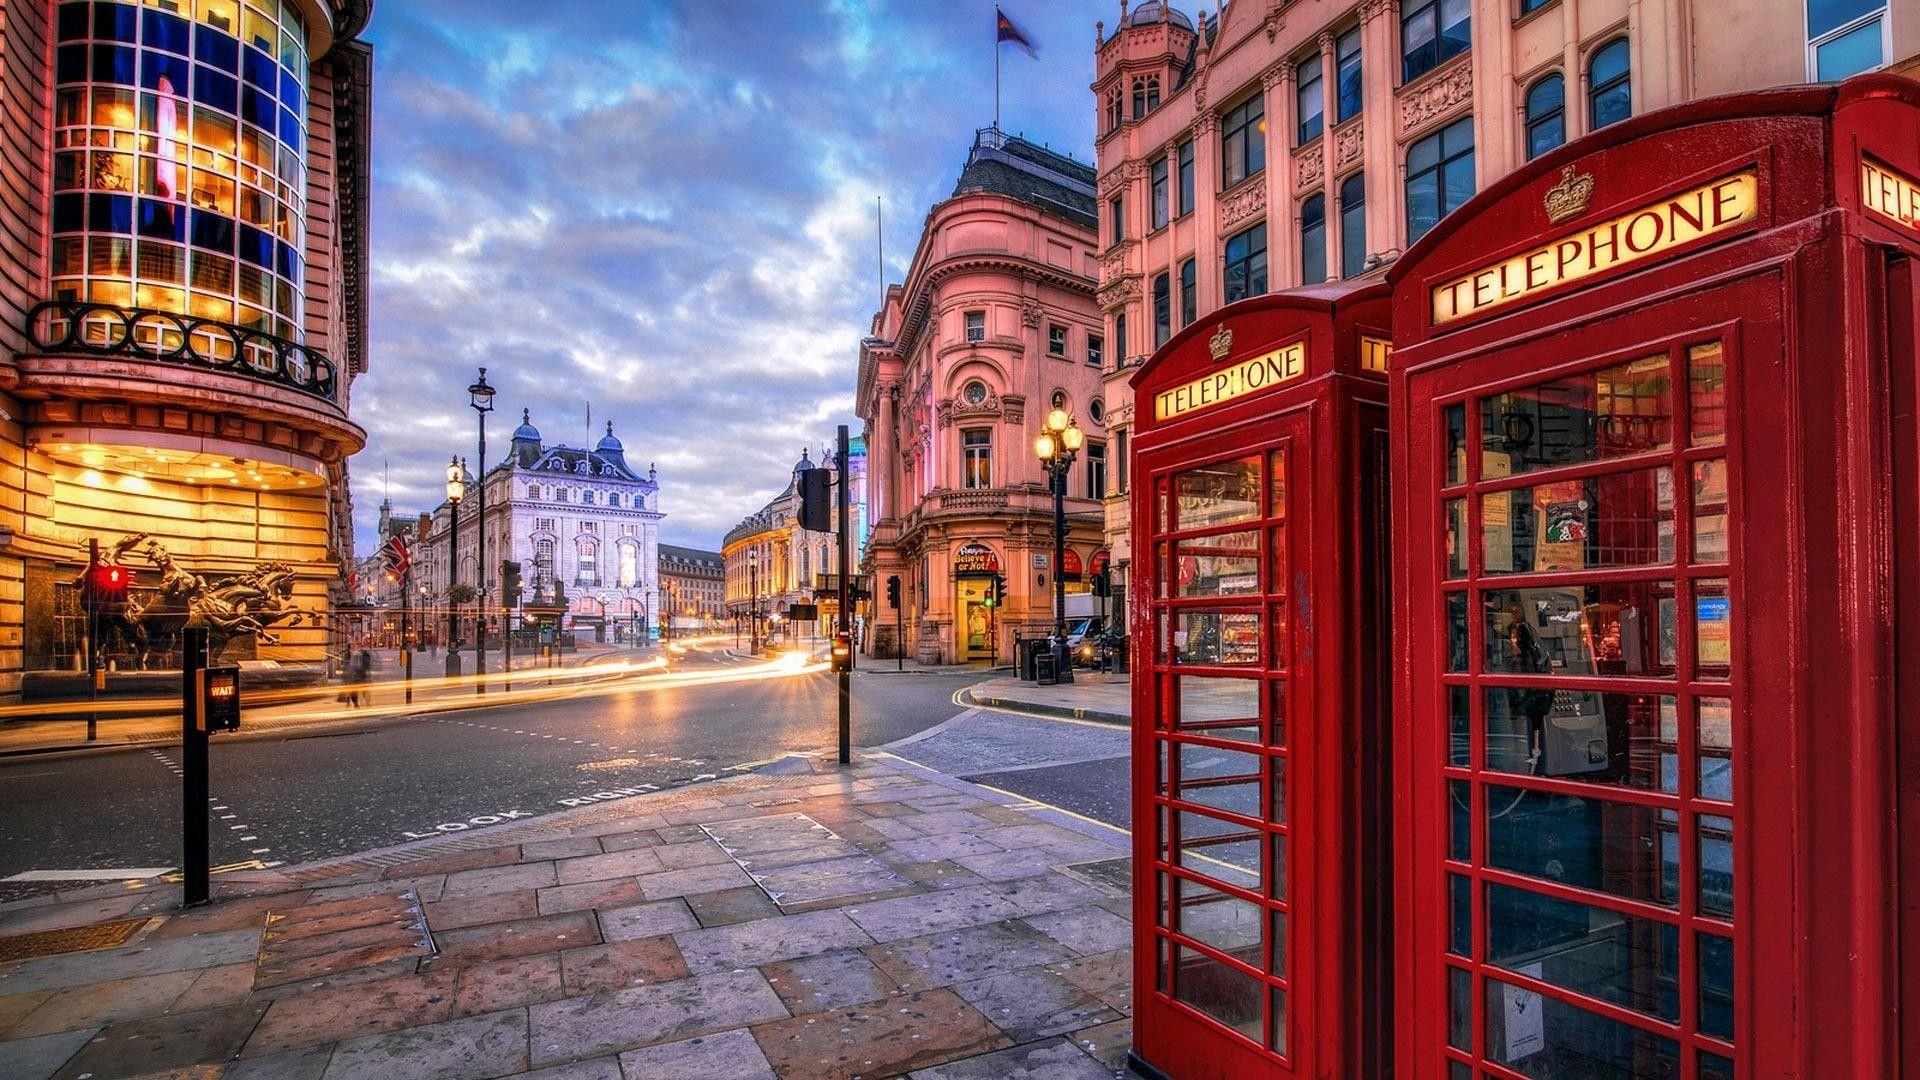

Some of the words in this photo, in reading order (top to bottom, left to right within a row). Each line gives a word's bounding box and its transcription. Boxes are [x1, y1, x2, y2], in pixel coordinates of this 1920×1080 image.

[1441, 177, 1742, 316] TELEPHONE
[954, 554, 985, 563] Believe
[211, 686, 234, 697] WAIT
[403, 809, 534, 839] LOOK
[557, 783, 660, 808] RIGHT
